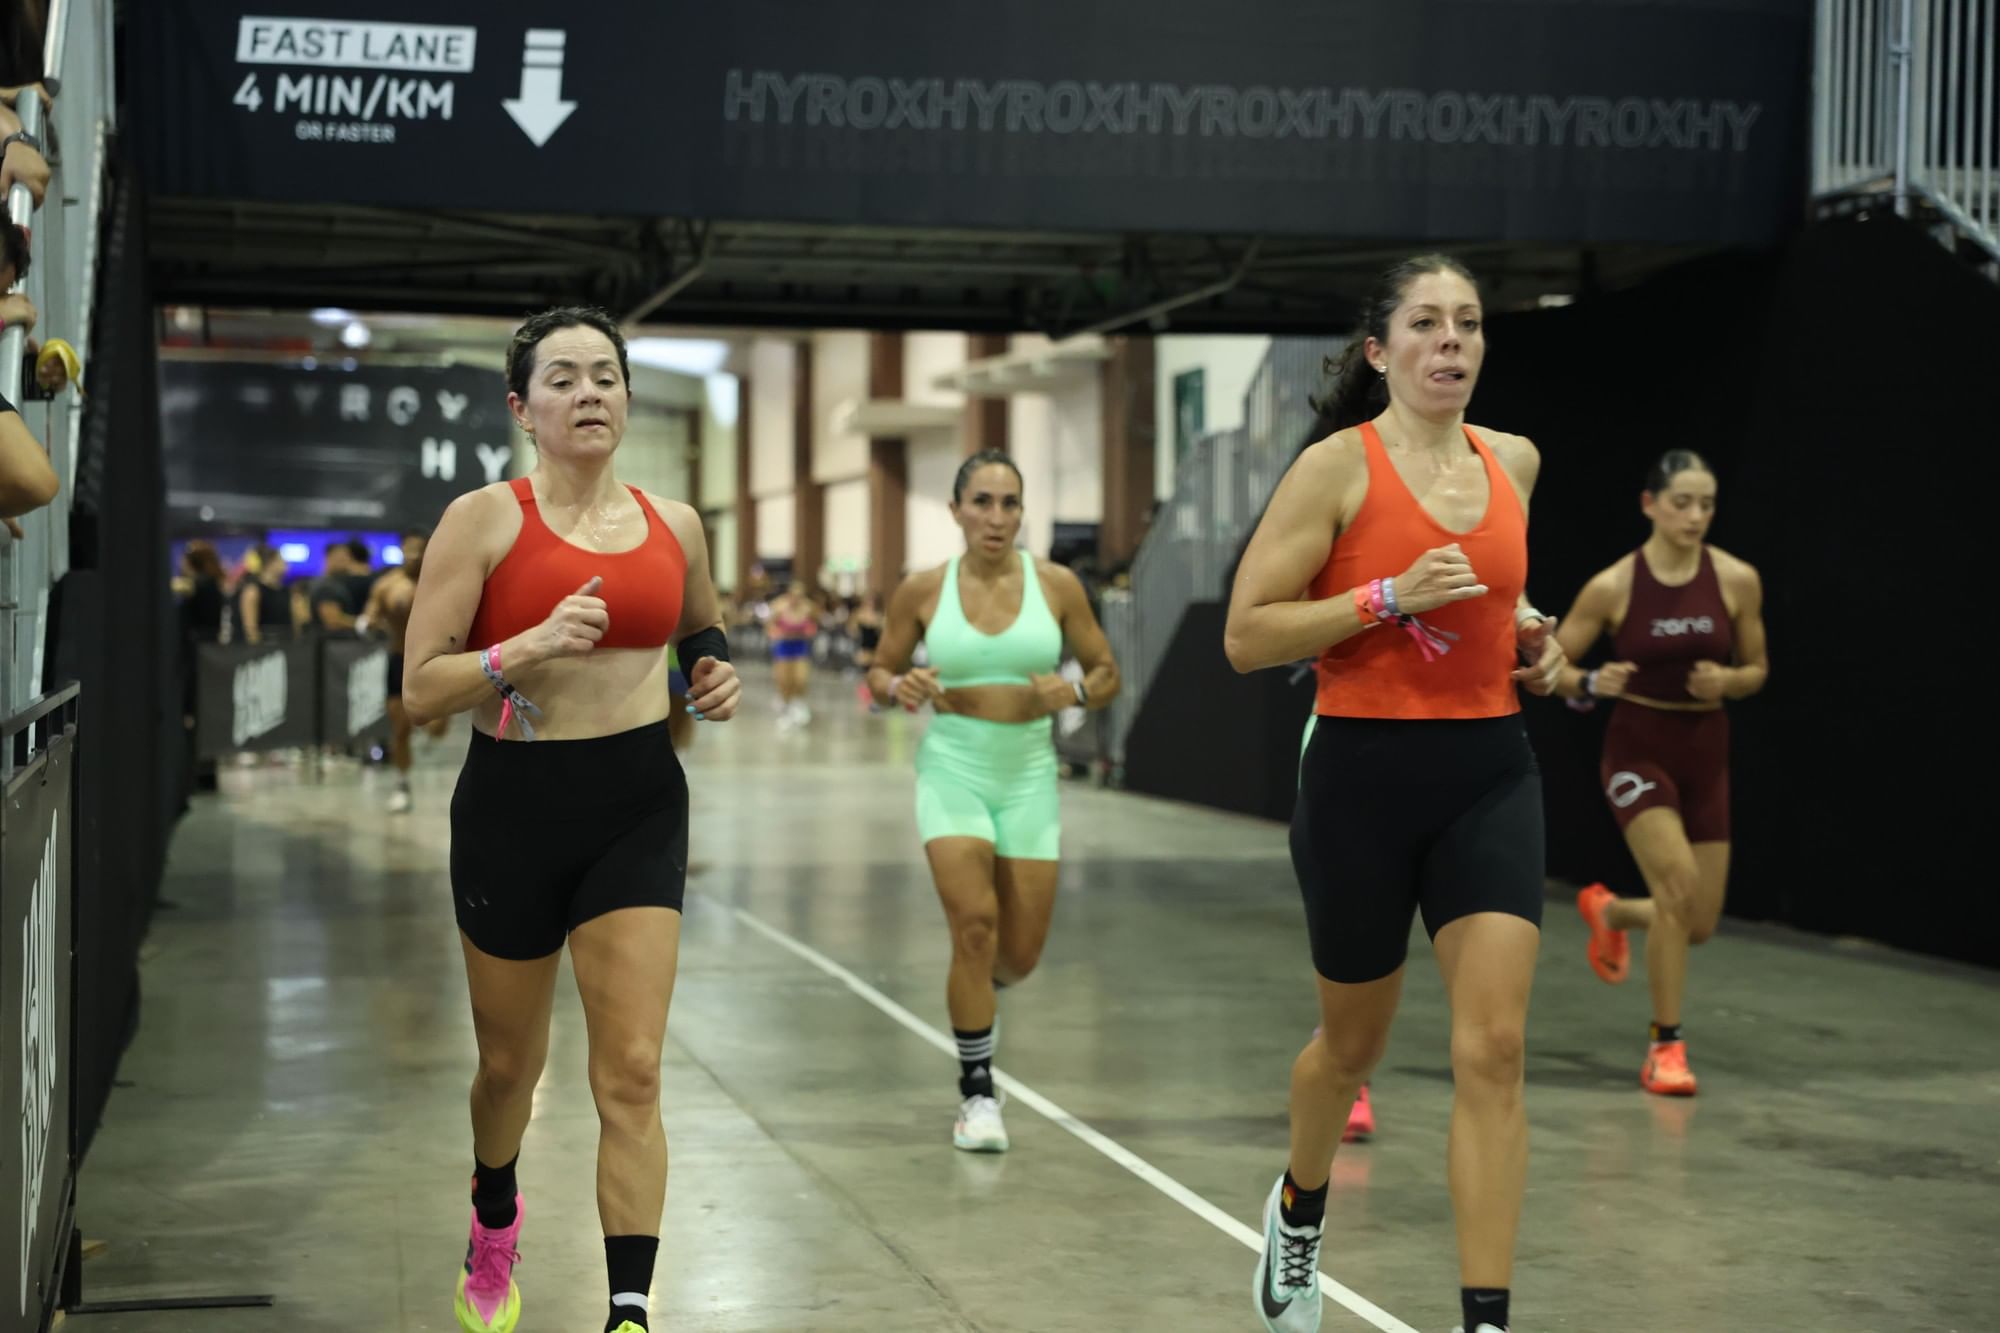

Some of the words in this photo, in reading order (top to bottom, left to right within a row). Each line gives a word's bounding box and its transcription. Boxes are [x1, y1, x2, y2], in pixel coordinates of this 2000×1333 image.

[250, 25, 350, 60] FAST
[363, 28, 467, 66] LANE
[233, 73, 263, 112] 4
[274, 73, 454, 121] MIN/KM
[295, 121, 322, 142] OR
[325, 121, 395, 144] FASTER
